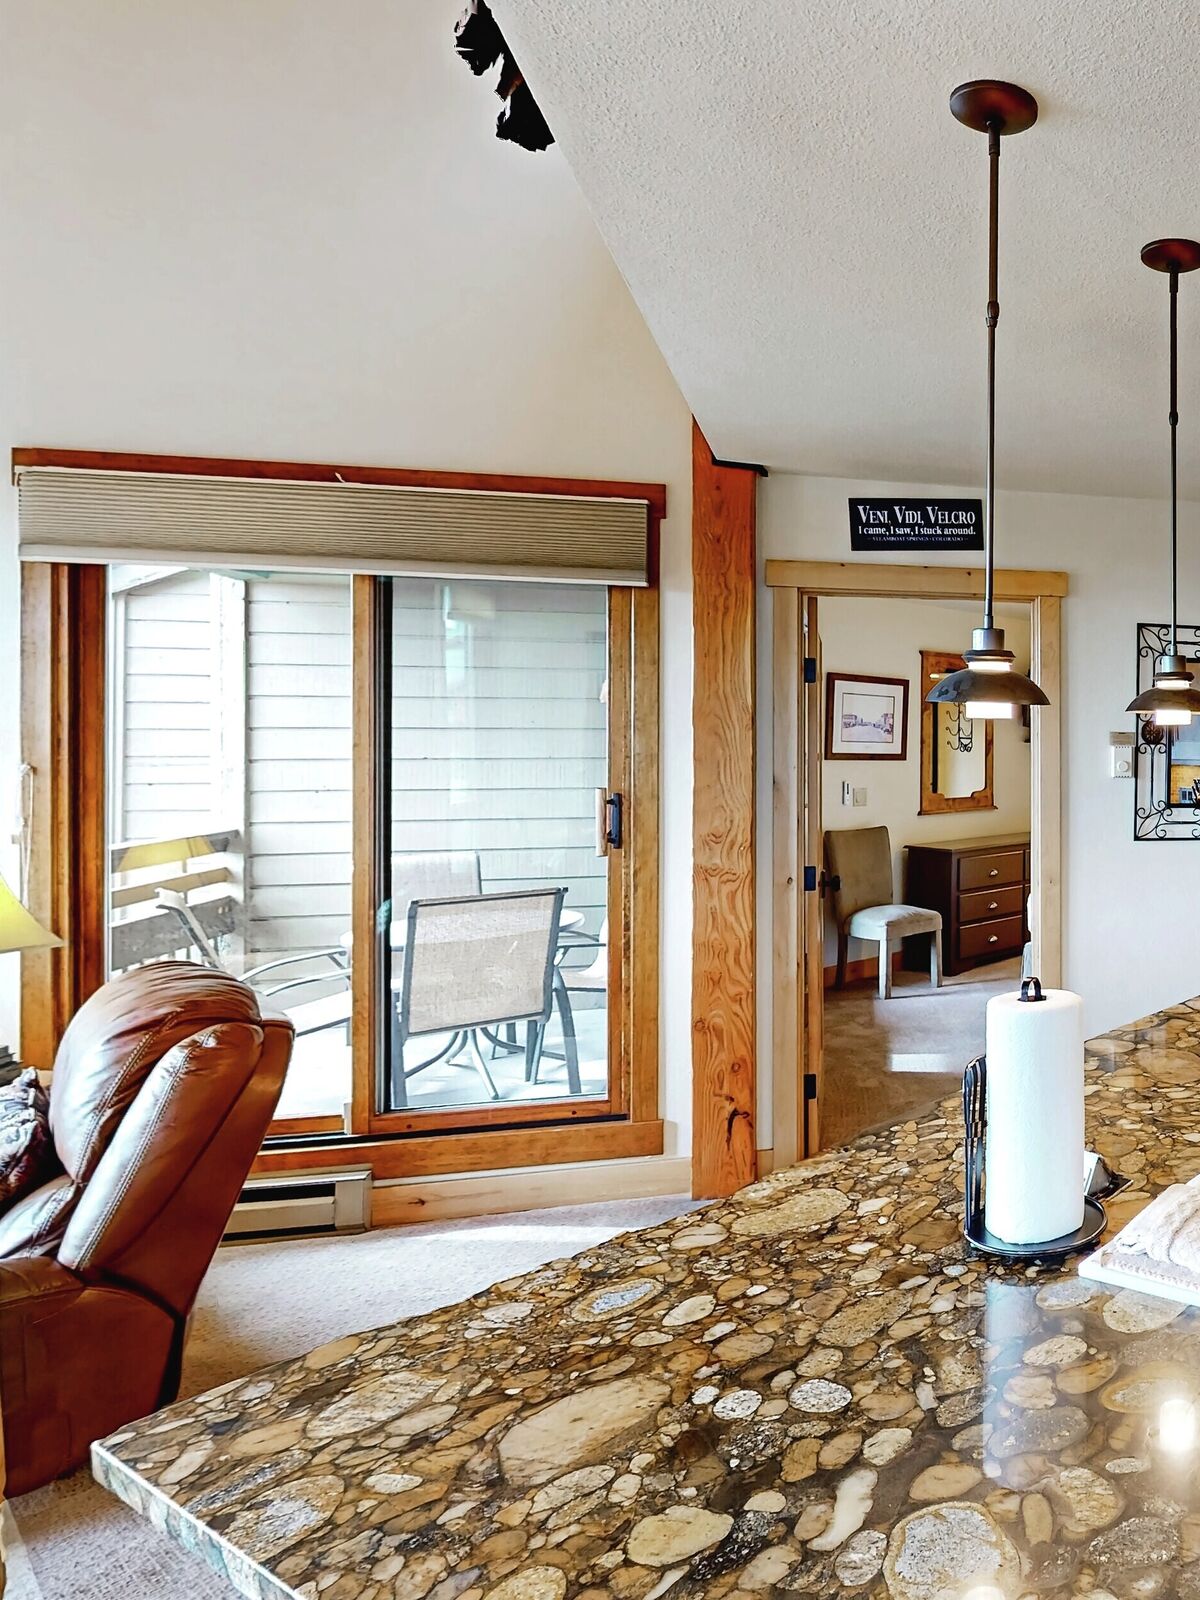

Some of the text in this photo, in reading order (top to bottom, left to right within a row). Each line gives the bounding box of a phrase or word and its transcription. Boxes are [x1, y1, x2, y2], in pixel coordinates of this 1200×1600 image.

[926, 506, 976, 524] VELCRO
[863, 526, 889, 536] came,
[895, 526, 914, 536] saw,
[920, 526, 942, 535] stuck
[943, 526, 976, 535] around.
